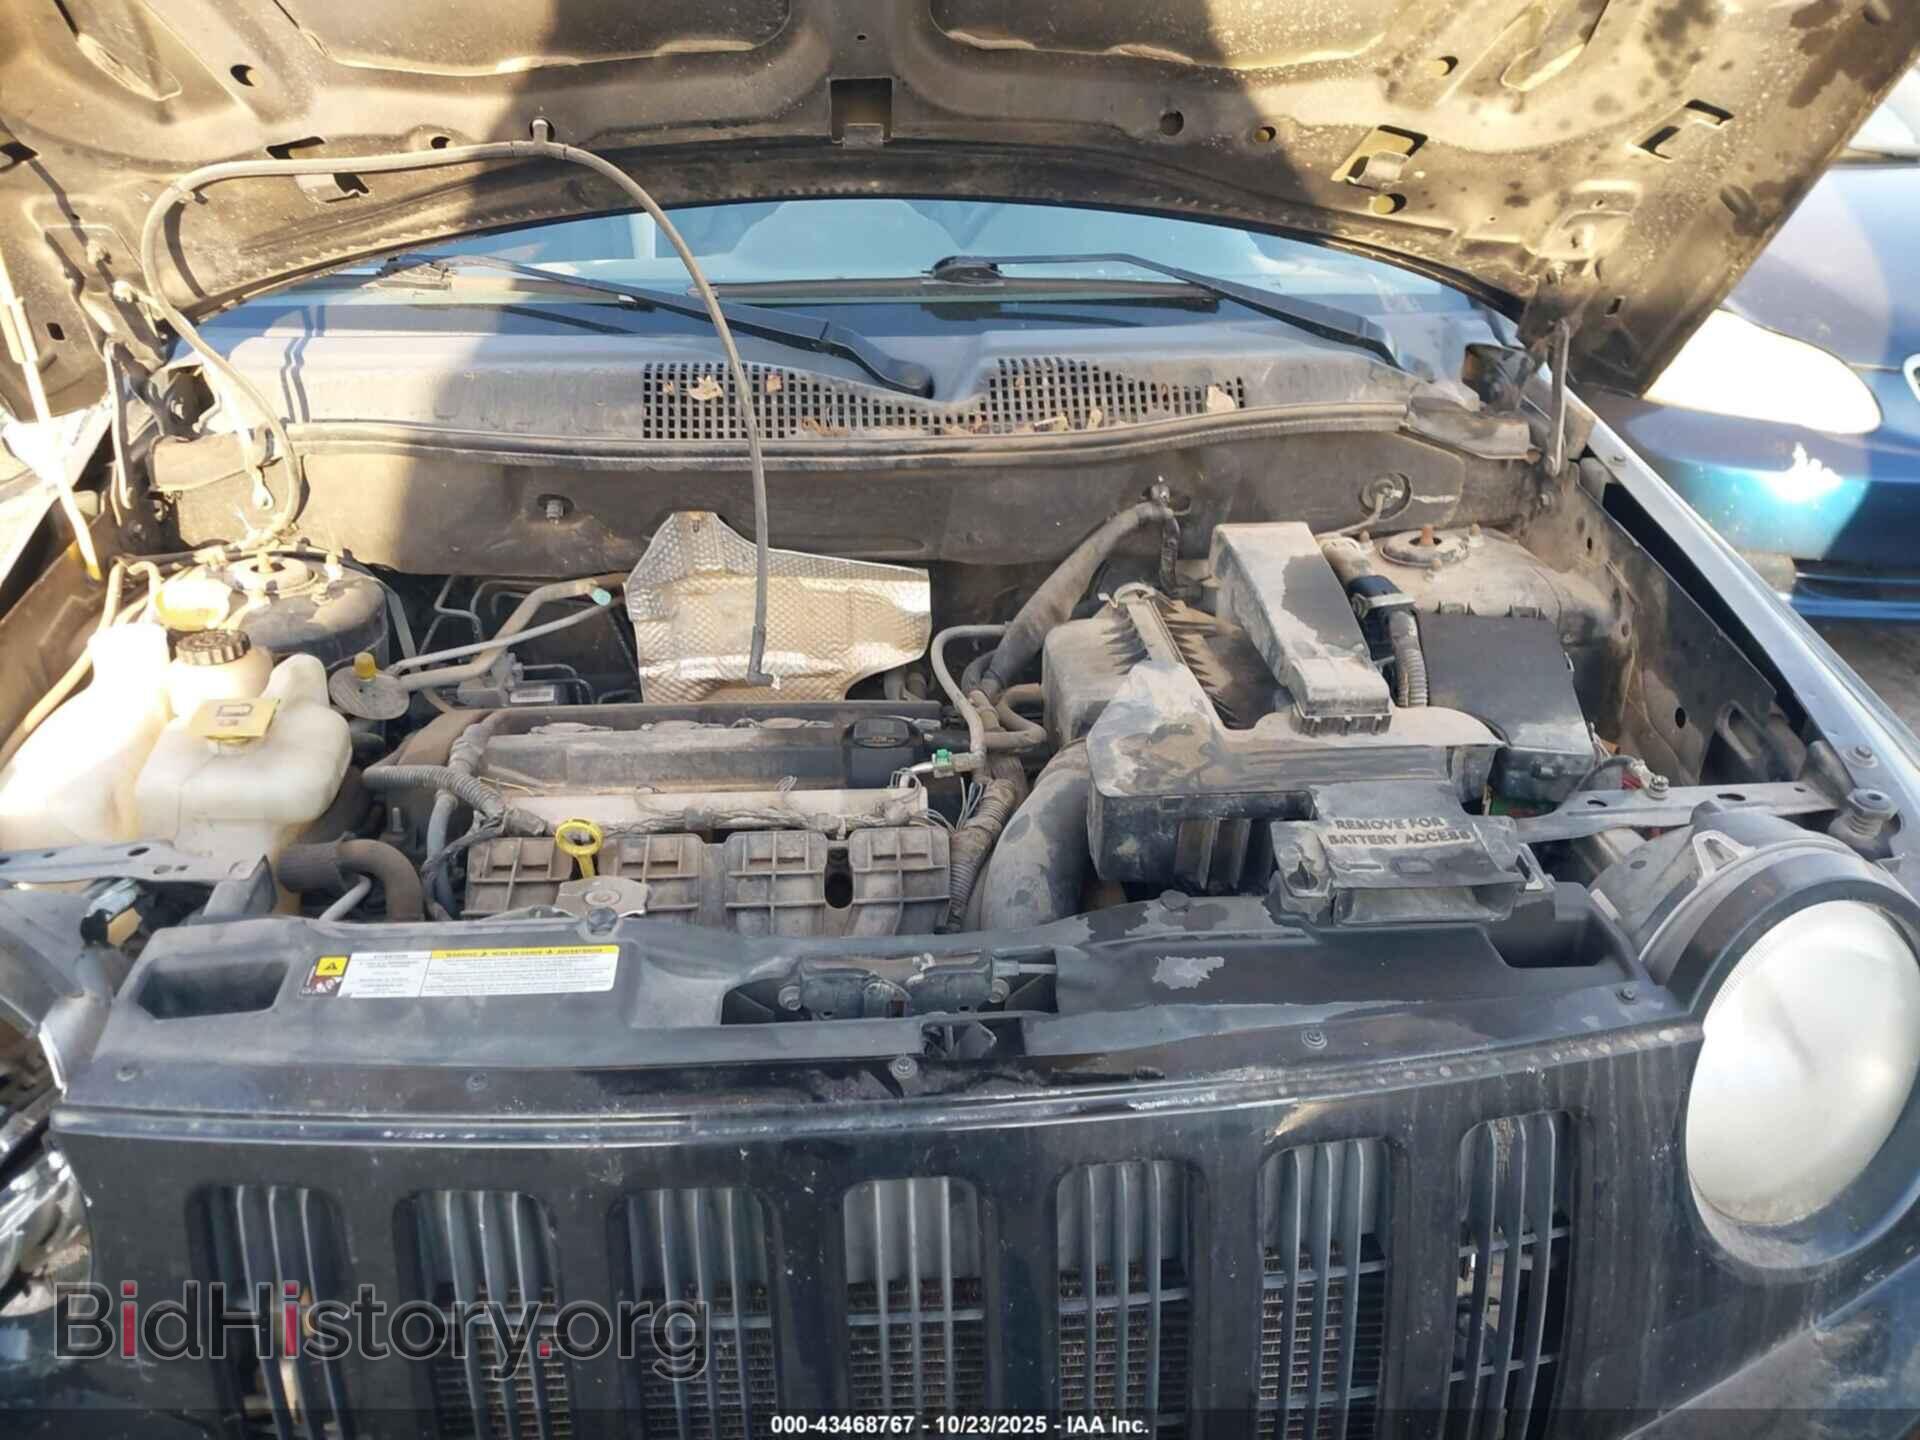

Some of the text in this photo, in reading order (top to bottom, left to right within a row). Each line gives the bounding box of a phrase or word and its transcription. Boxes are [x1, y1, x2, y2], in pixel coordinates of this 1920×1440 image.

[1335, 816, 1446, 831] REMOVE FOR
[1327, 830, 1472, 846] BATTERY ACCESS
